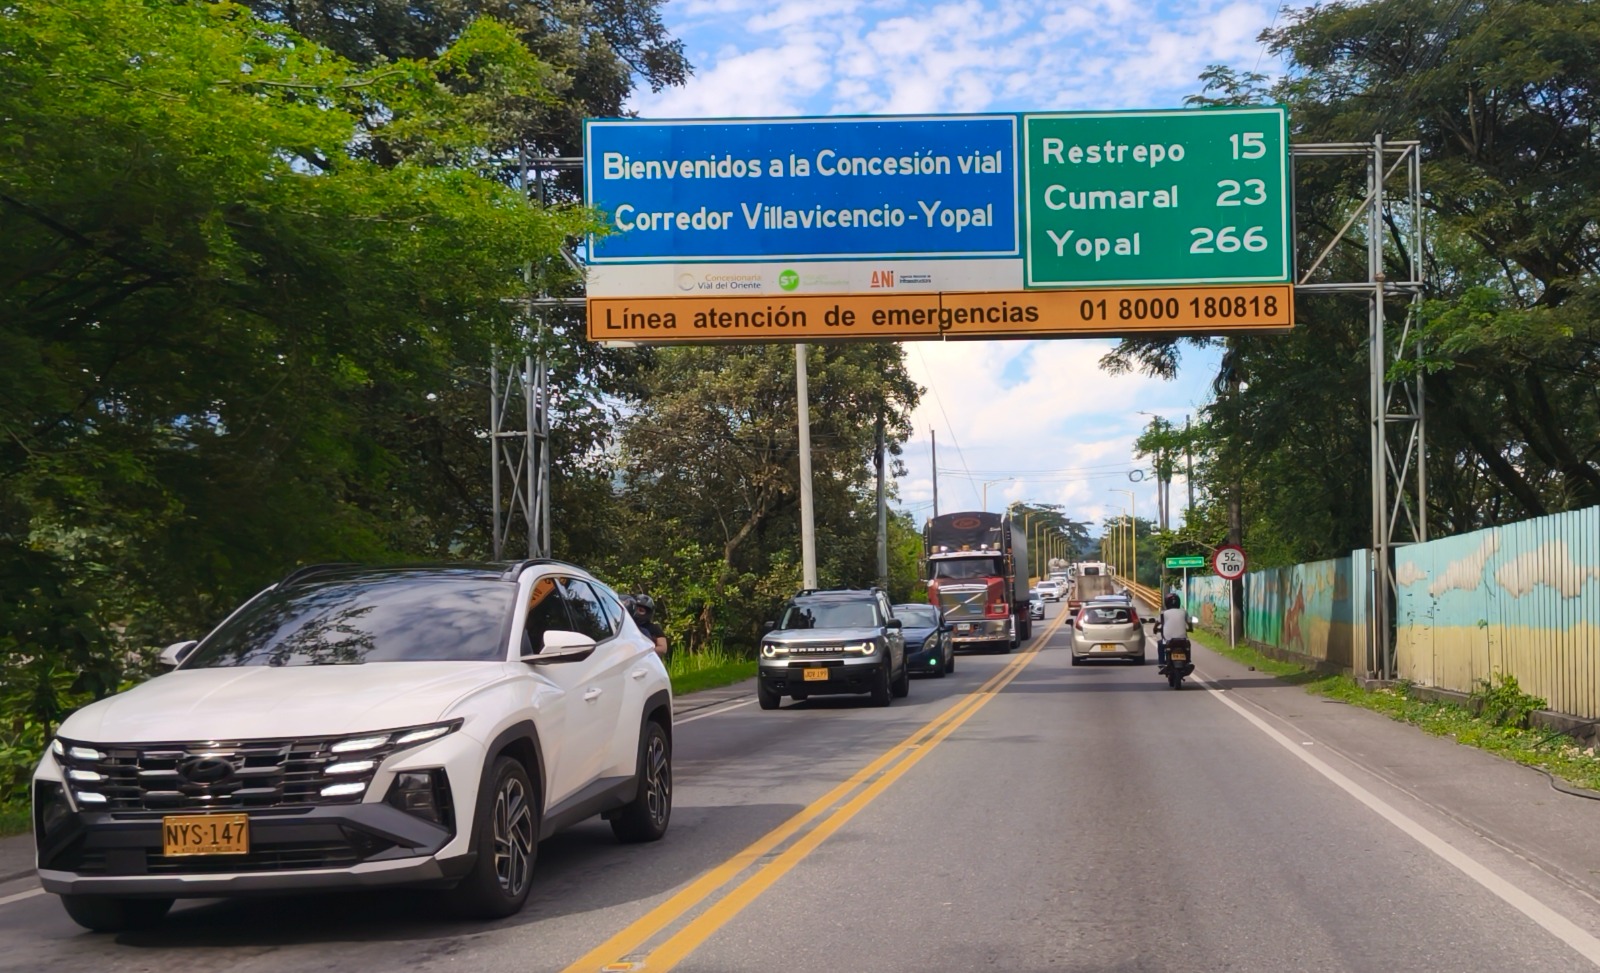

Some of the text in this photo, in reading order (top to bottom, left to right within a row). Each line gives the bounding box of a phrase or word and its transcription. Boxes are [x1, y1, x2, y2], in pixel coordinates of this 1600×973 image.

[603, 149, 1002, 180] Bienvenidos a la Concesión vial
[1042, 132, 1267, 168] Restrepo 15
[1044, 178, 1267, 210] Cumaral 23
[615, 200, 993, 233] Corredor Villavicencio-Yopal
[1046, 226, 1268, 262] Yopal 266
[715, 281, 728, 290] del
[730, 281, 762, 290] Oriente
[606, 295, 1278, 330] Línea atención de emergencias 01 8000 180818
[1221, 562, 1240, 572] Ton
[1224, 552, 1236, 562] 52
